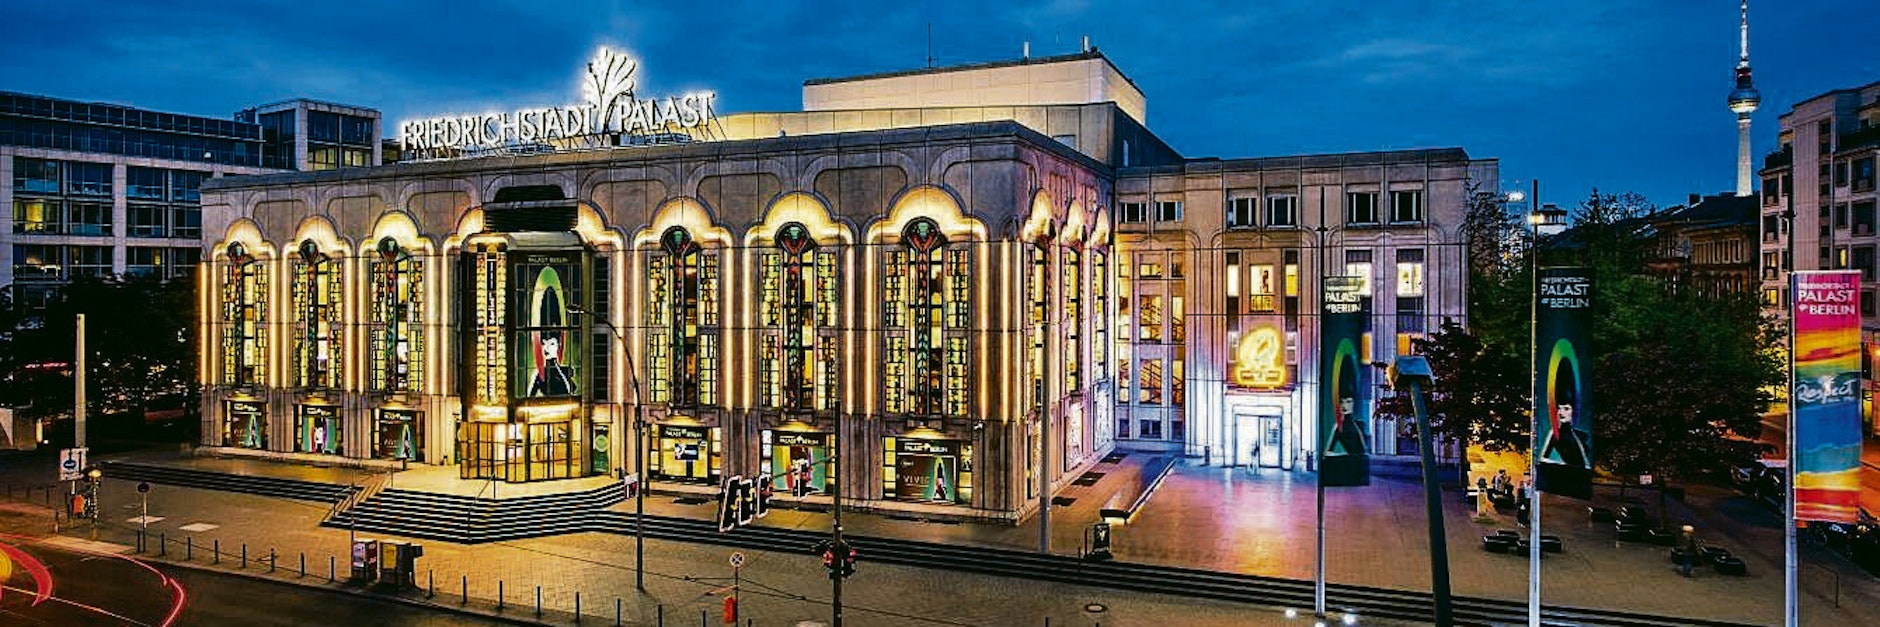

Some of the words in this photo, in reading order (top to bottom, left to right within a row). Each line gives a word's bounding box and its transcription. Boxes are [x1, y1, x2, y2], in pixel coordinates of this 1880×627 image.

[400, 104, 596, 151] FRIEDRICHSTADT
[617, 93, 715, 133] PALAST
[1541, 284, 1590, 296] PALAST
[1798, 289, 1857, 303] PALAST
[1325, 292, 1360, 302] PALAST
[1331, 303, 1362, 313] BERLIN
[1550, 298, 1590, 309] BERLIN
[1809, 304, 1857, 316] BERLIN
